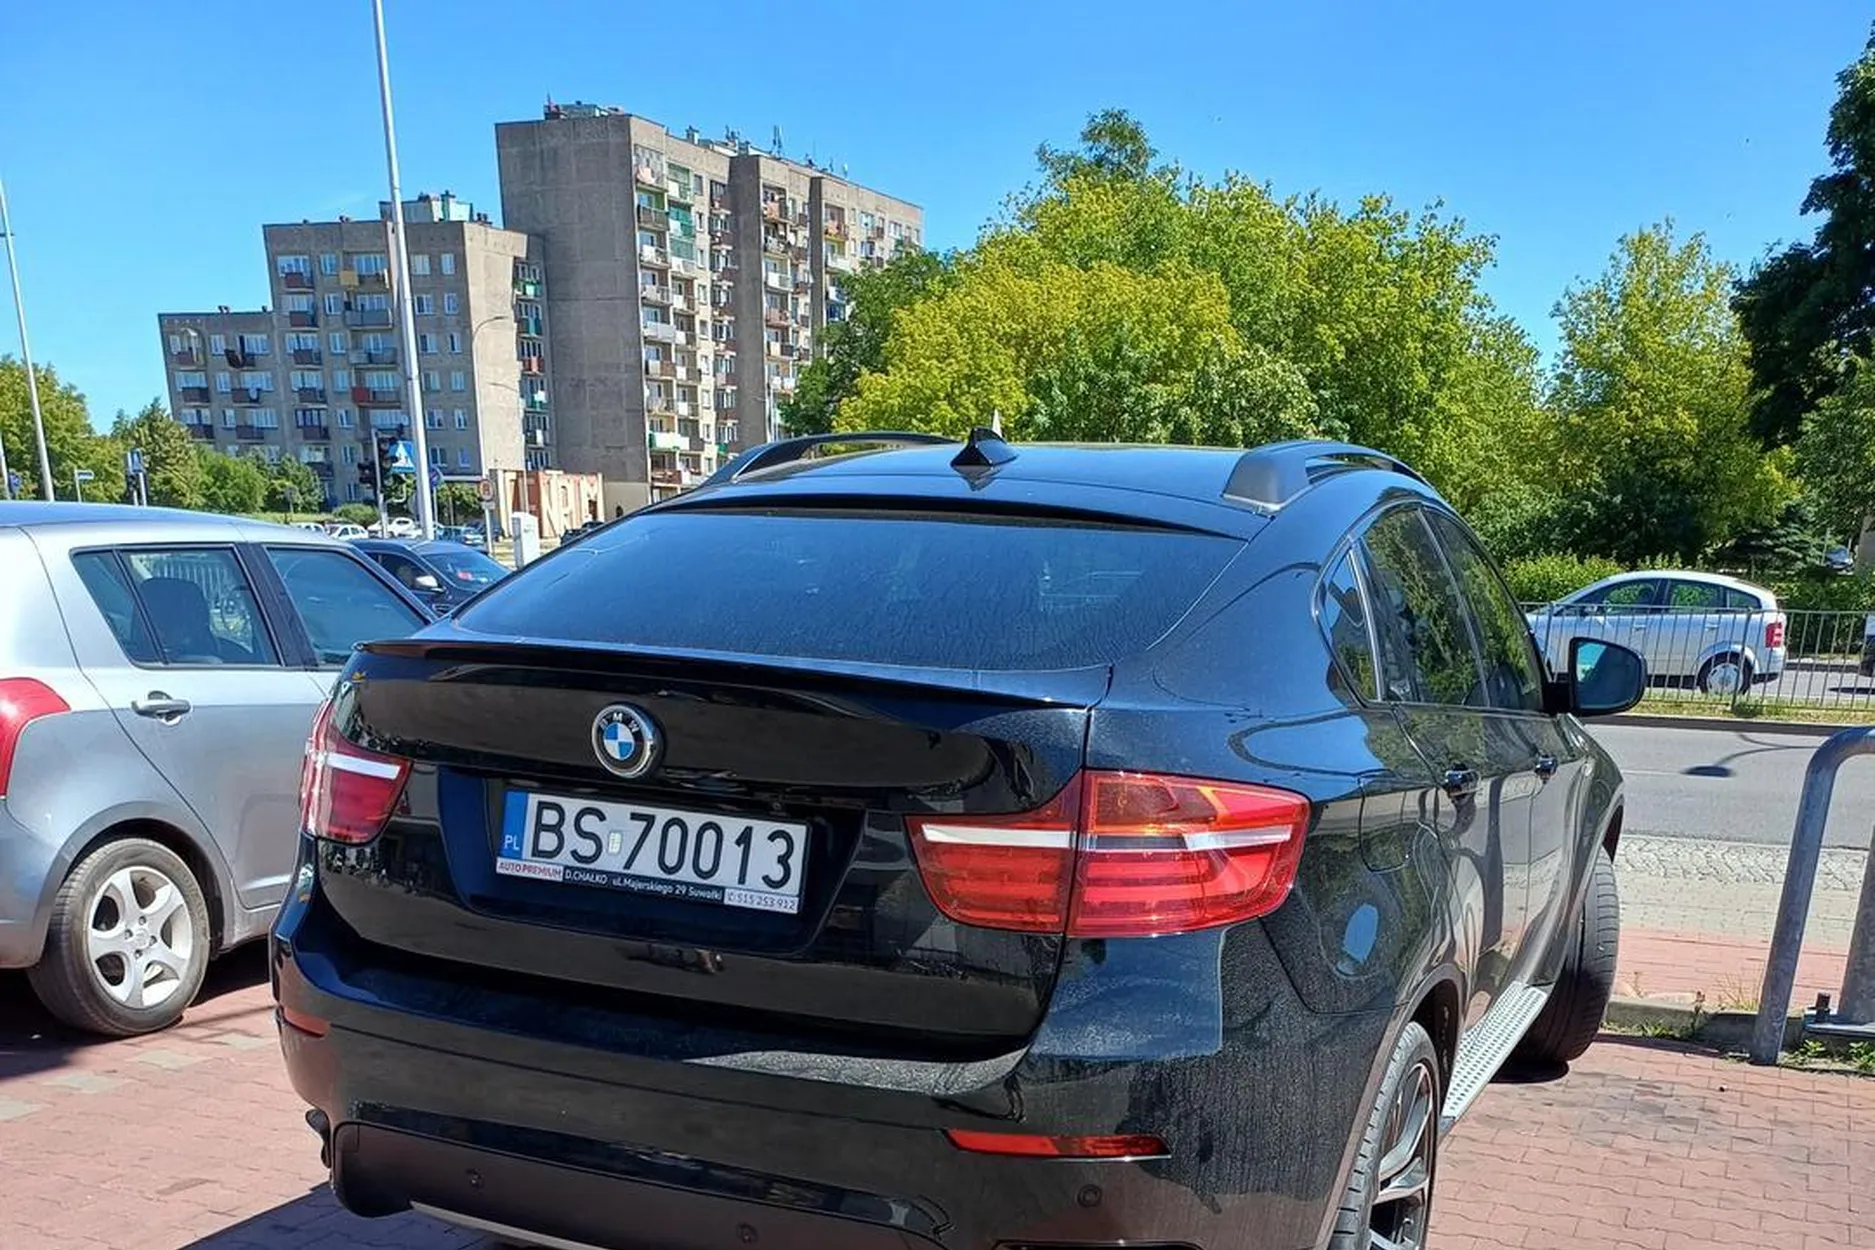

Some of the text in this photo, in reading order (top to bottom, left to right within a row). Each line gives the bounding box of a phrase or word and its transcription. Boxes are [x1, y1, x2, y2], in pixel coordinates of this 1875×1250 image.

[599, 711, 640, 733] BMW
[504, 834, 520, 850] PL
[531, 801, 794, 889] BS 70013
